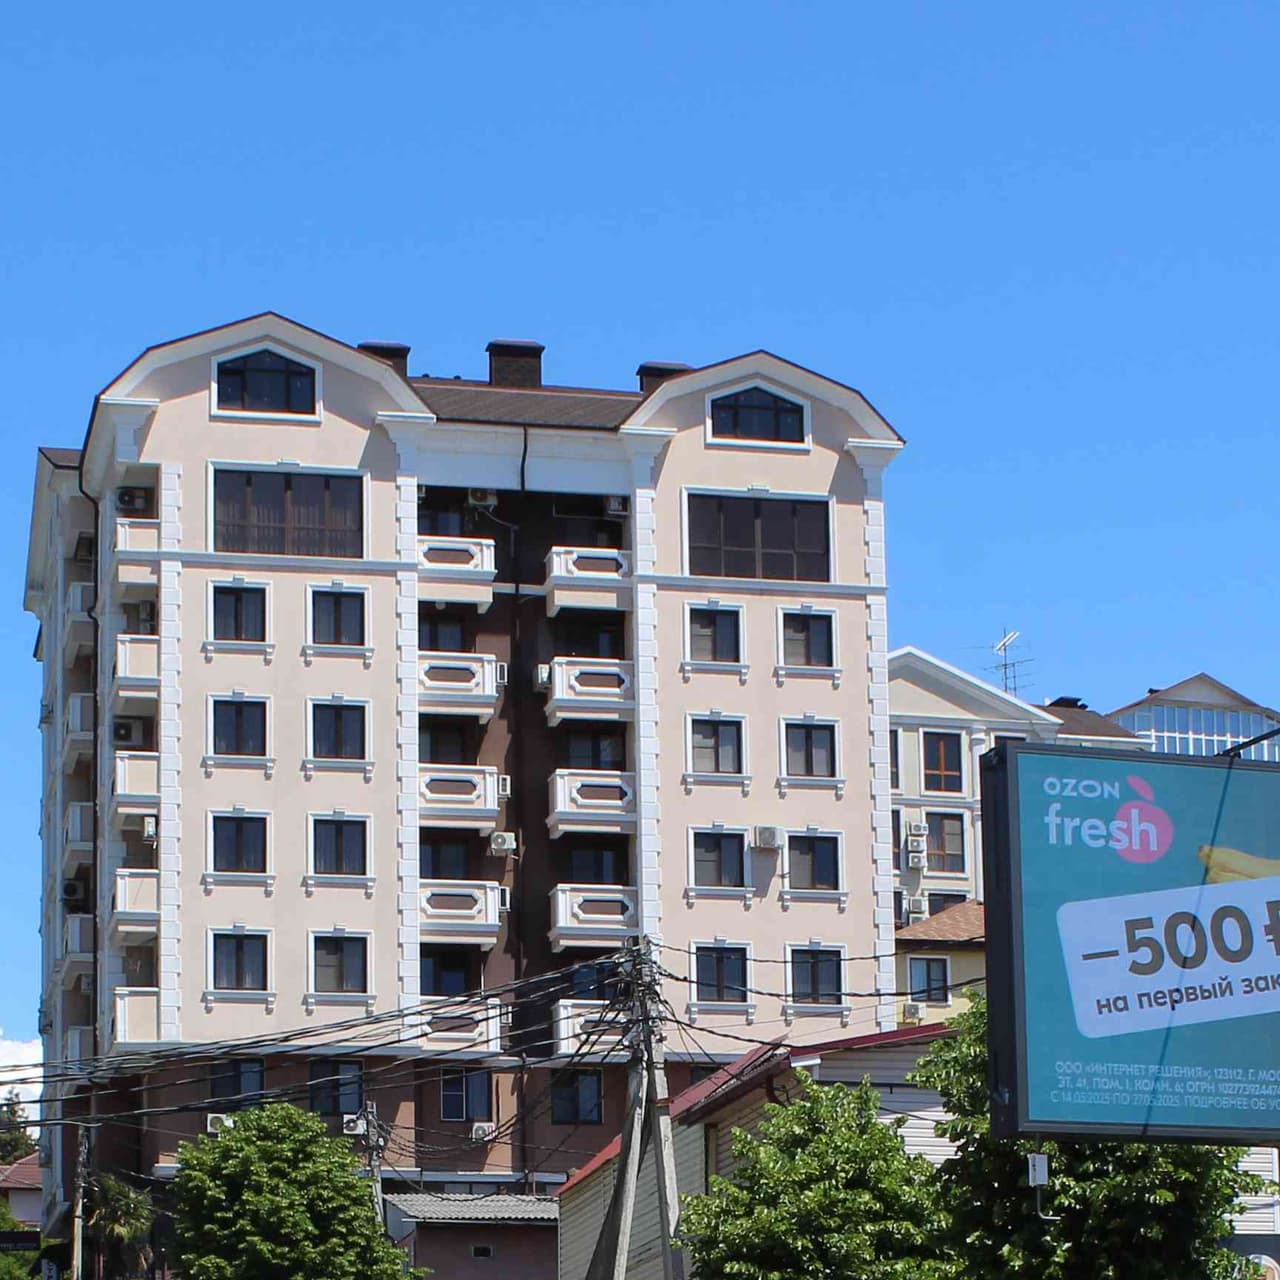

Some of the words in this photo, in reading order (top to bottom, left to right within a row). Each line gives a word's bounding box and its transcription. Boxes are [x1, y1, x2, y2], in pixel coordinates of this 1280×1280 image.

[1043, 777, 1120, 800] OZON
[1043, 802, 1158, 851] fresh
[1096, 995, 1129, 1015] на
[1137, 975, 1234, 1011] первый
[1186, 1081, 1215, 1093] ОГРН
